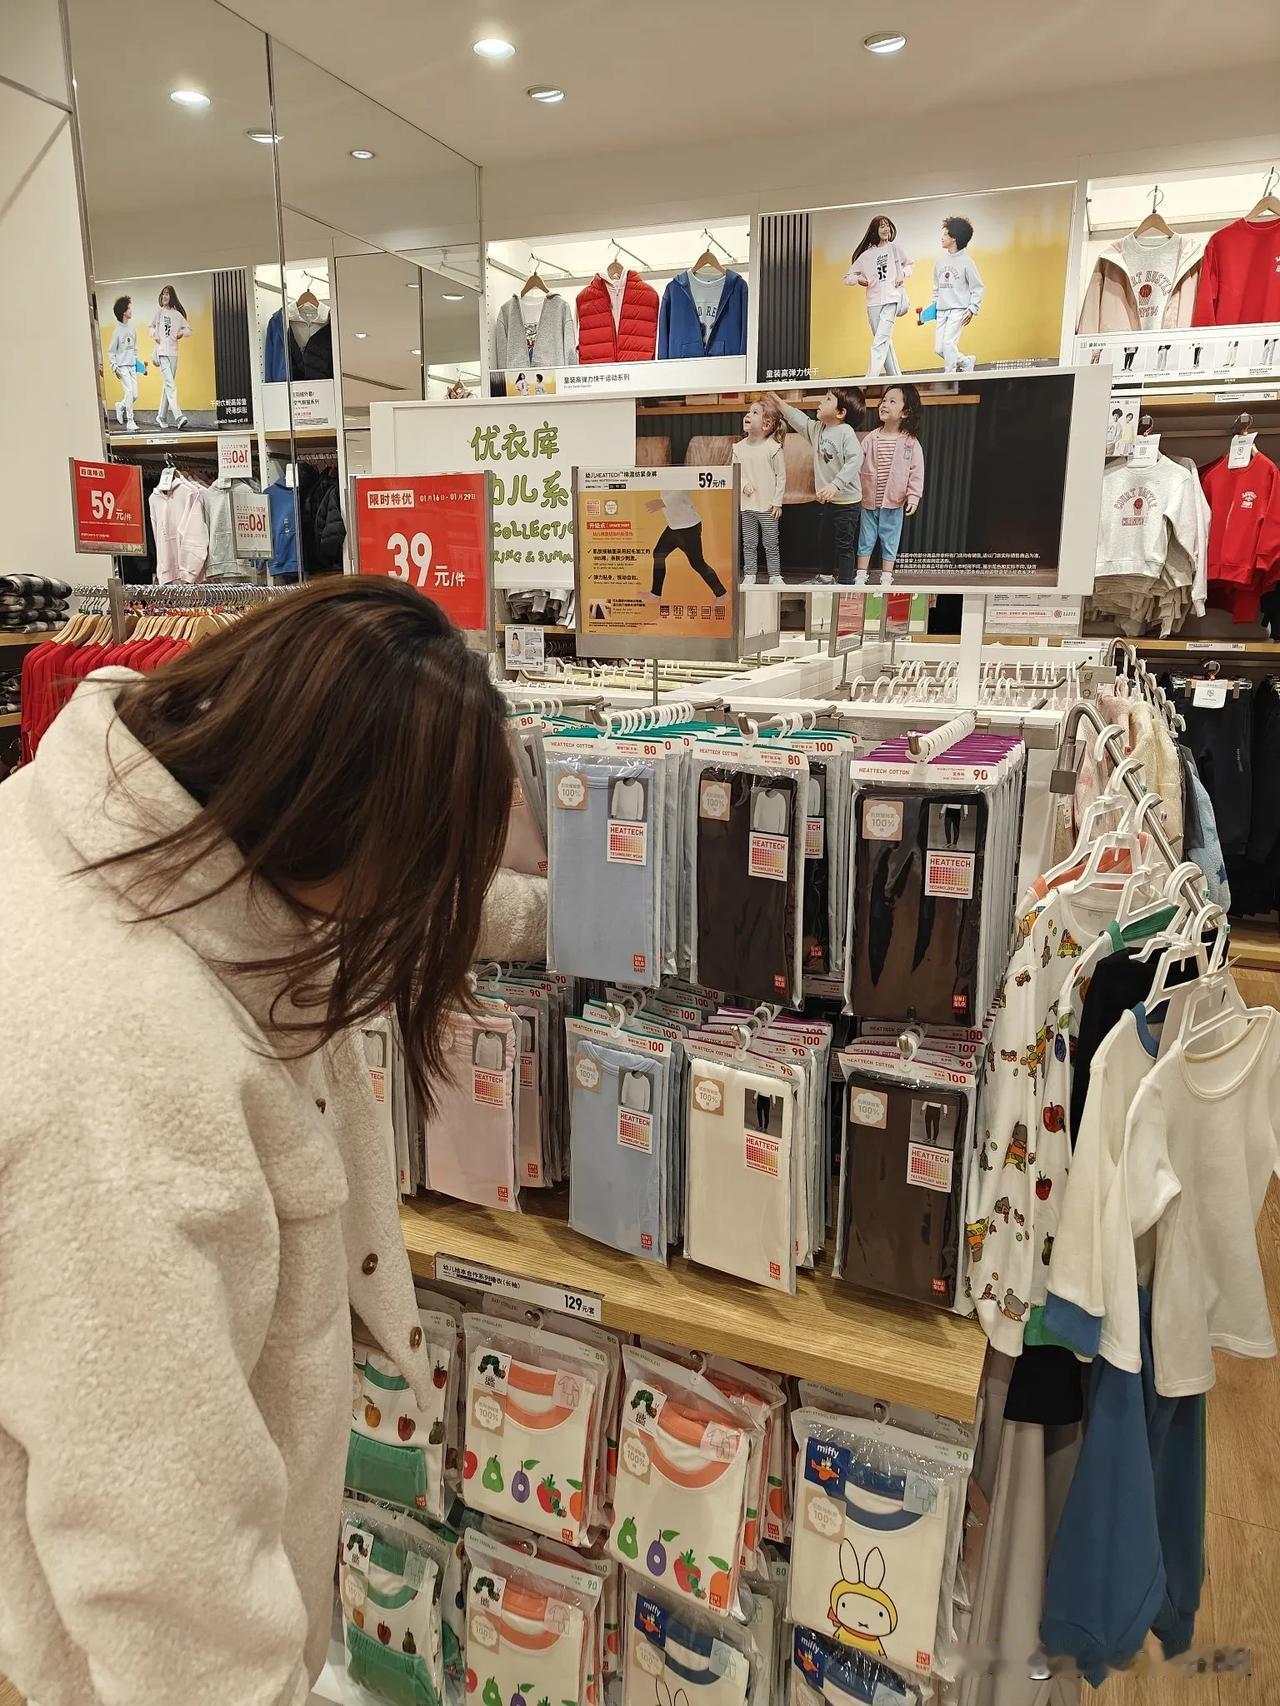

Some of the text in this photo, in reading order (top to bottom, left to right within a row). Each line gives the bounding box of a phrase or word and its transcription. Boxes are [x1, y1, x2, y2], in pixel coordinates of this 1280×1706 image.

[766, 368, 819, 378] 童装高弹力快干
[471, 421, 559, 461] 优衣库
[698, 473, 726, 488] 59 元/件
[369, 493, 412, 506] 限时特优
[90, 490, 132, 521] 59 元/件
[387, 532, 466, 587] 39 元/件
[521, 716, 533, 726] 80
[644, 745, 657, 755] 80
[816, 742, 833, 752] 100
[787, 755, 801, 765] 80
[972, 769, 988, 780] 90
[872, 818, 895, 827] 100%
[610, 826, 644, 836] HEATTECH
[752, 840, 785, 850] HEATTECH
[930, 858, 971, 868] HEATTECH
[555, 976, 566, 984] 90
[529, 989, 541, 998] 90
[695, 997, 708, 1007] 100
[681, 1010, 695, 1020] 100
[572, 1023, 593, 1034] HEATTECH
[662, 1029, 677, 1040] 100
[965, 1029, 983, 1040] 100
[648, 1041, 664, 1052] 100
[803, 1036, 820, 1046] 100
[692, 1044, 732, 1058] HEATTECH COTTON
[792, 1047, 805, 1057] 90
[958, 1043, 976, 1053] 100
[847, 1057, 895, 1069] HEATTECH COTTON
[959, 1060, 972, 1069] 90
[781, 1065, 792, 1076] 90
[475, 1072, 504, 1083] HEATTECH
[947, 1073, 967, 1084] 100
[858, 1104, 880, 1115] 100%
[620, 1112, 650, 1126] HEATTECH
[746, 1137, 779, 1152] HEATTECH
[911, 1150, 950, 1164] HEATTECH
[565, 1294, 582, 1311] 129
[479, 1408, 499, 1421] 100%
[816, 1443, 840, 1459] miffy
[956, 1451, 969, 1461] 90
[627, 1450, 645, 1466] 100%
[813, 1509, 839, 1525] 100%
[775, 1567, 786, 1576] 80
[587, 1579, 598, 1590] 90
[643, 1600, 662, 1617] miffy
[801, 1635, 820, 1655] miffy
